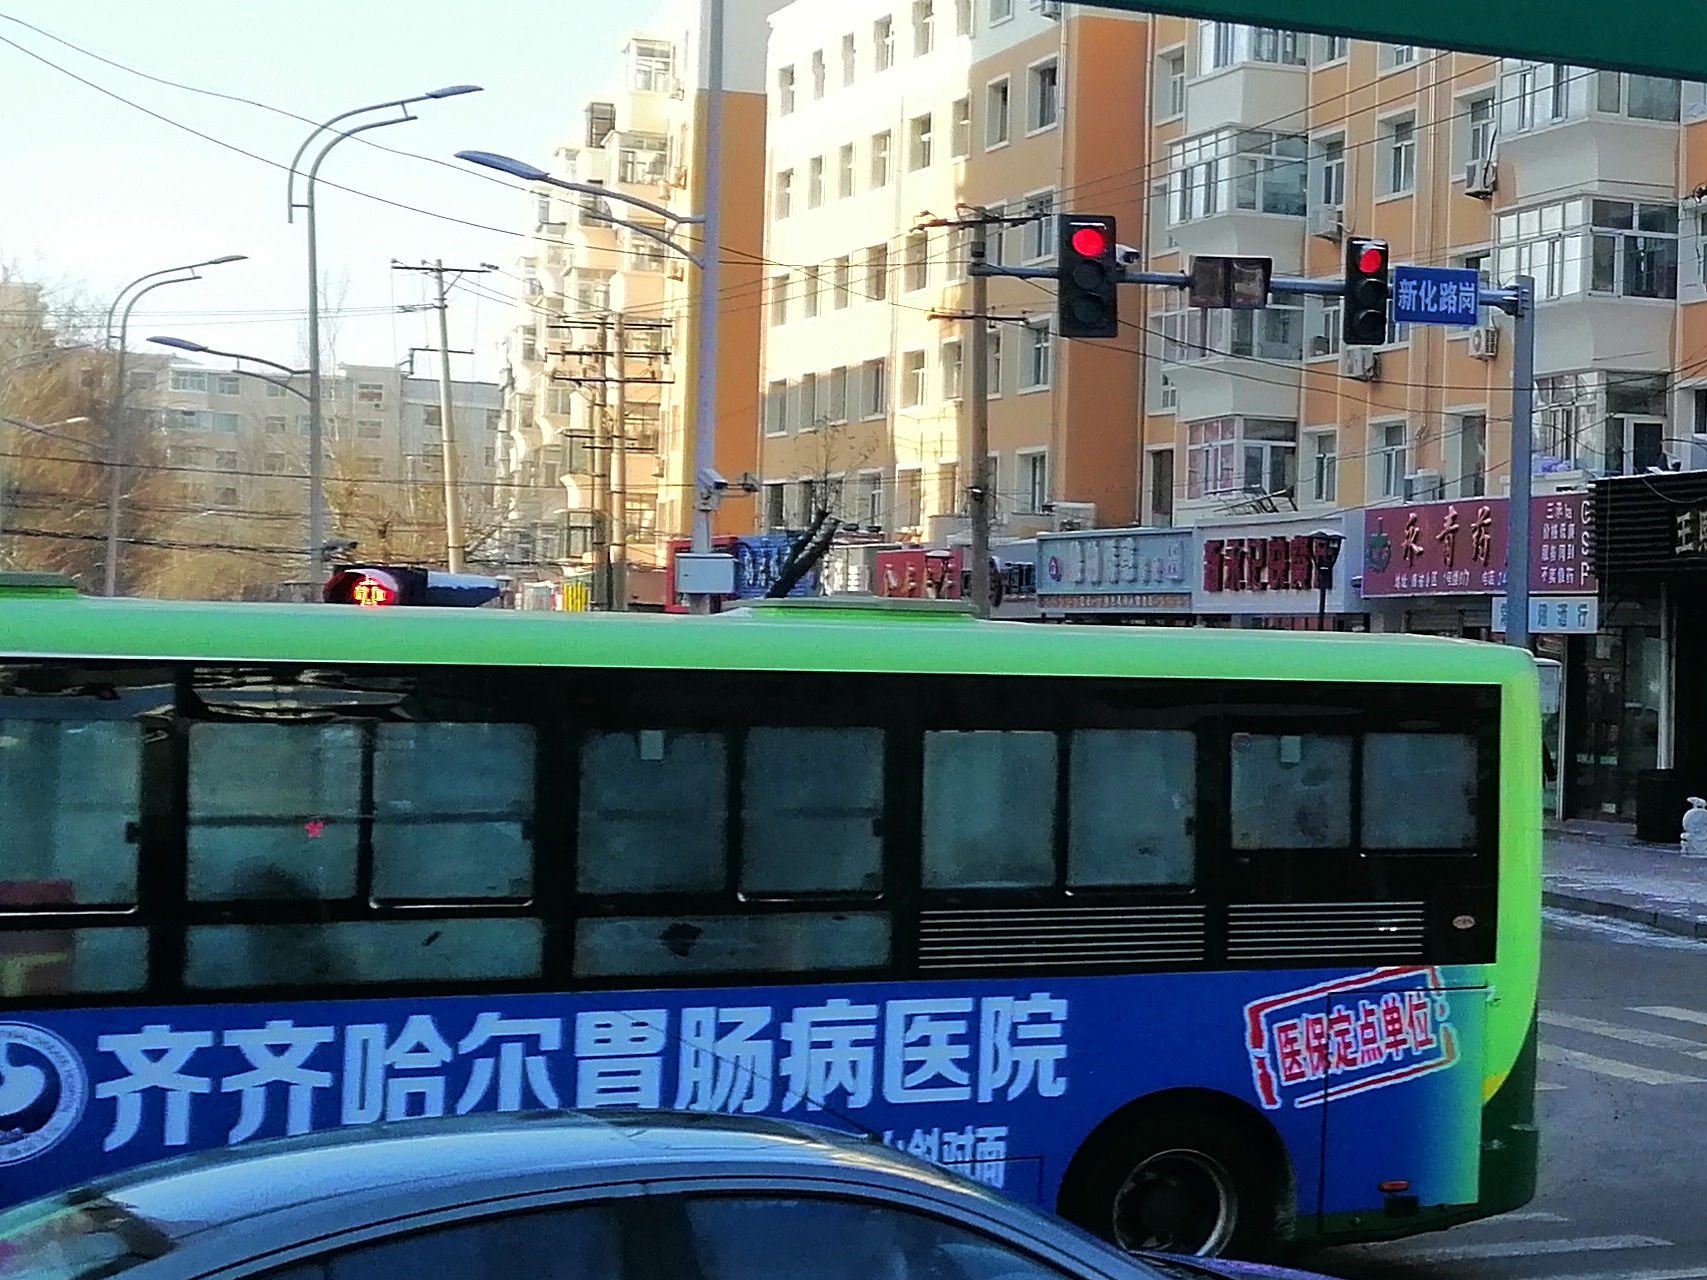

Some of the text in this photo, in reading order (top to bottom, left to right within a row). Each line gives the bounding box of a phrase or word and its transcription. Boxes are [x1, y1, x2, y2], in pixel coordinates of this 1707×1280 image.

[1398, 279, 1475, 314] 新化路岗
[94, 998, 1068, 1154] 齐齐哈尔胃肠病医院
[1275, 984, 1435, 1084] 医保定点单位
